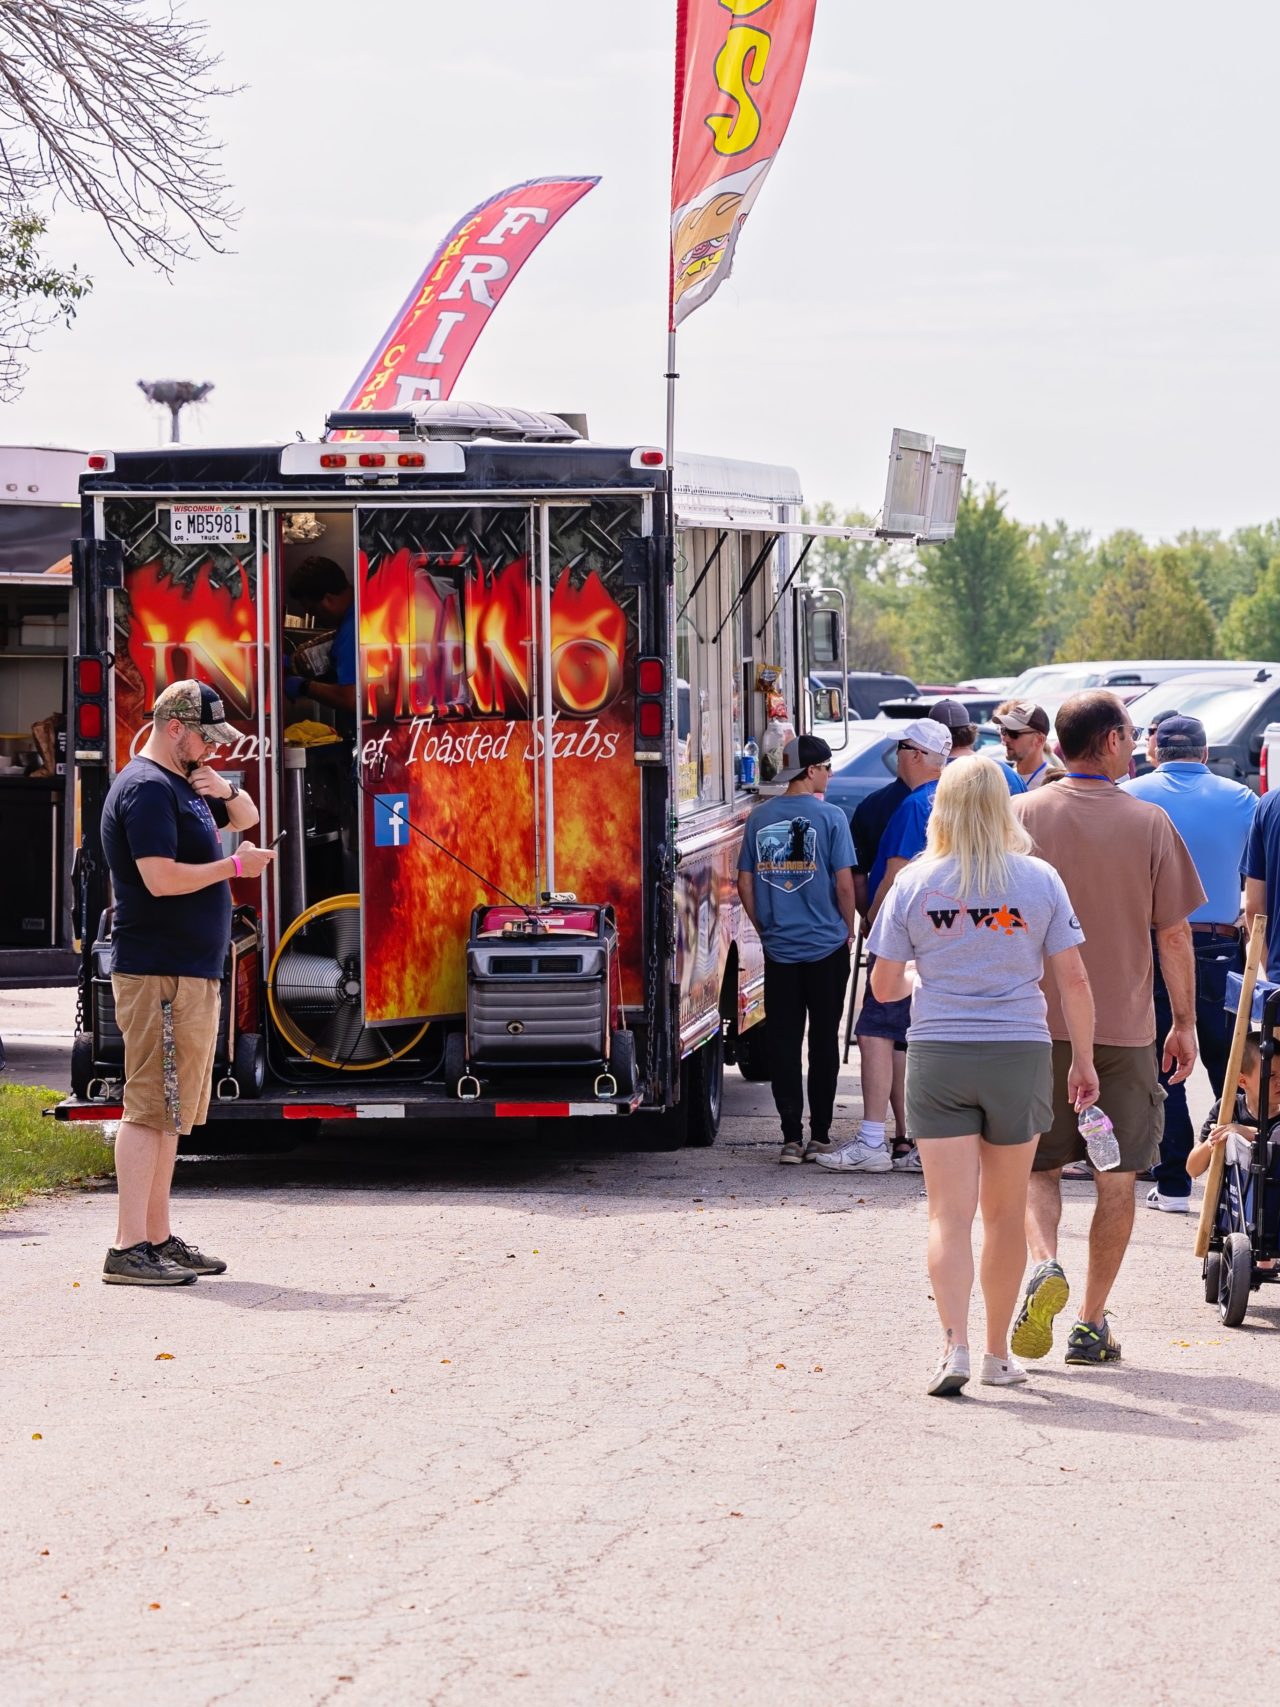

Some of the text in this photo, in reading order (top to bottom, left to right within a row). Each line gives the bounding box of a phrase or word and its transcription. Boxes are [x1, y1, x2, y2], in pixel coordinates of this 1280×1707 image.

[174, 505, 215, 513] WISCONSIN
[175, 514, 241, 534] C MB5981
[405, 713, 516, 767] Toasted
[522, 710, 620, 762] Subs
[756, 861, 817, 871] COLUMBIA
